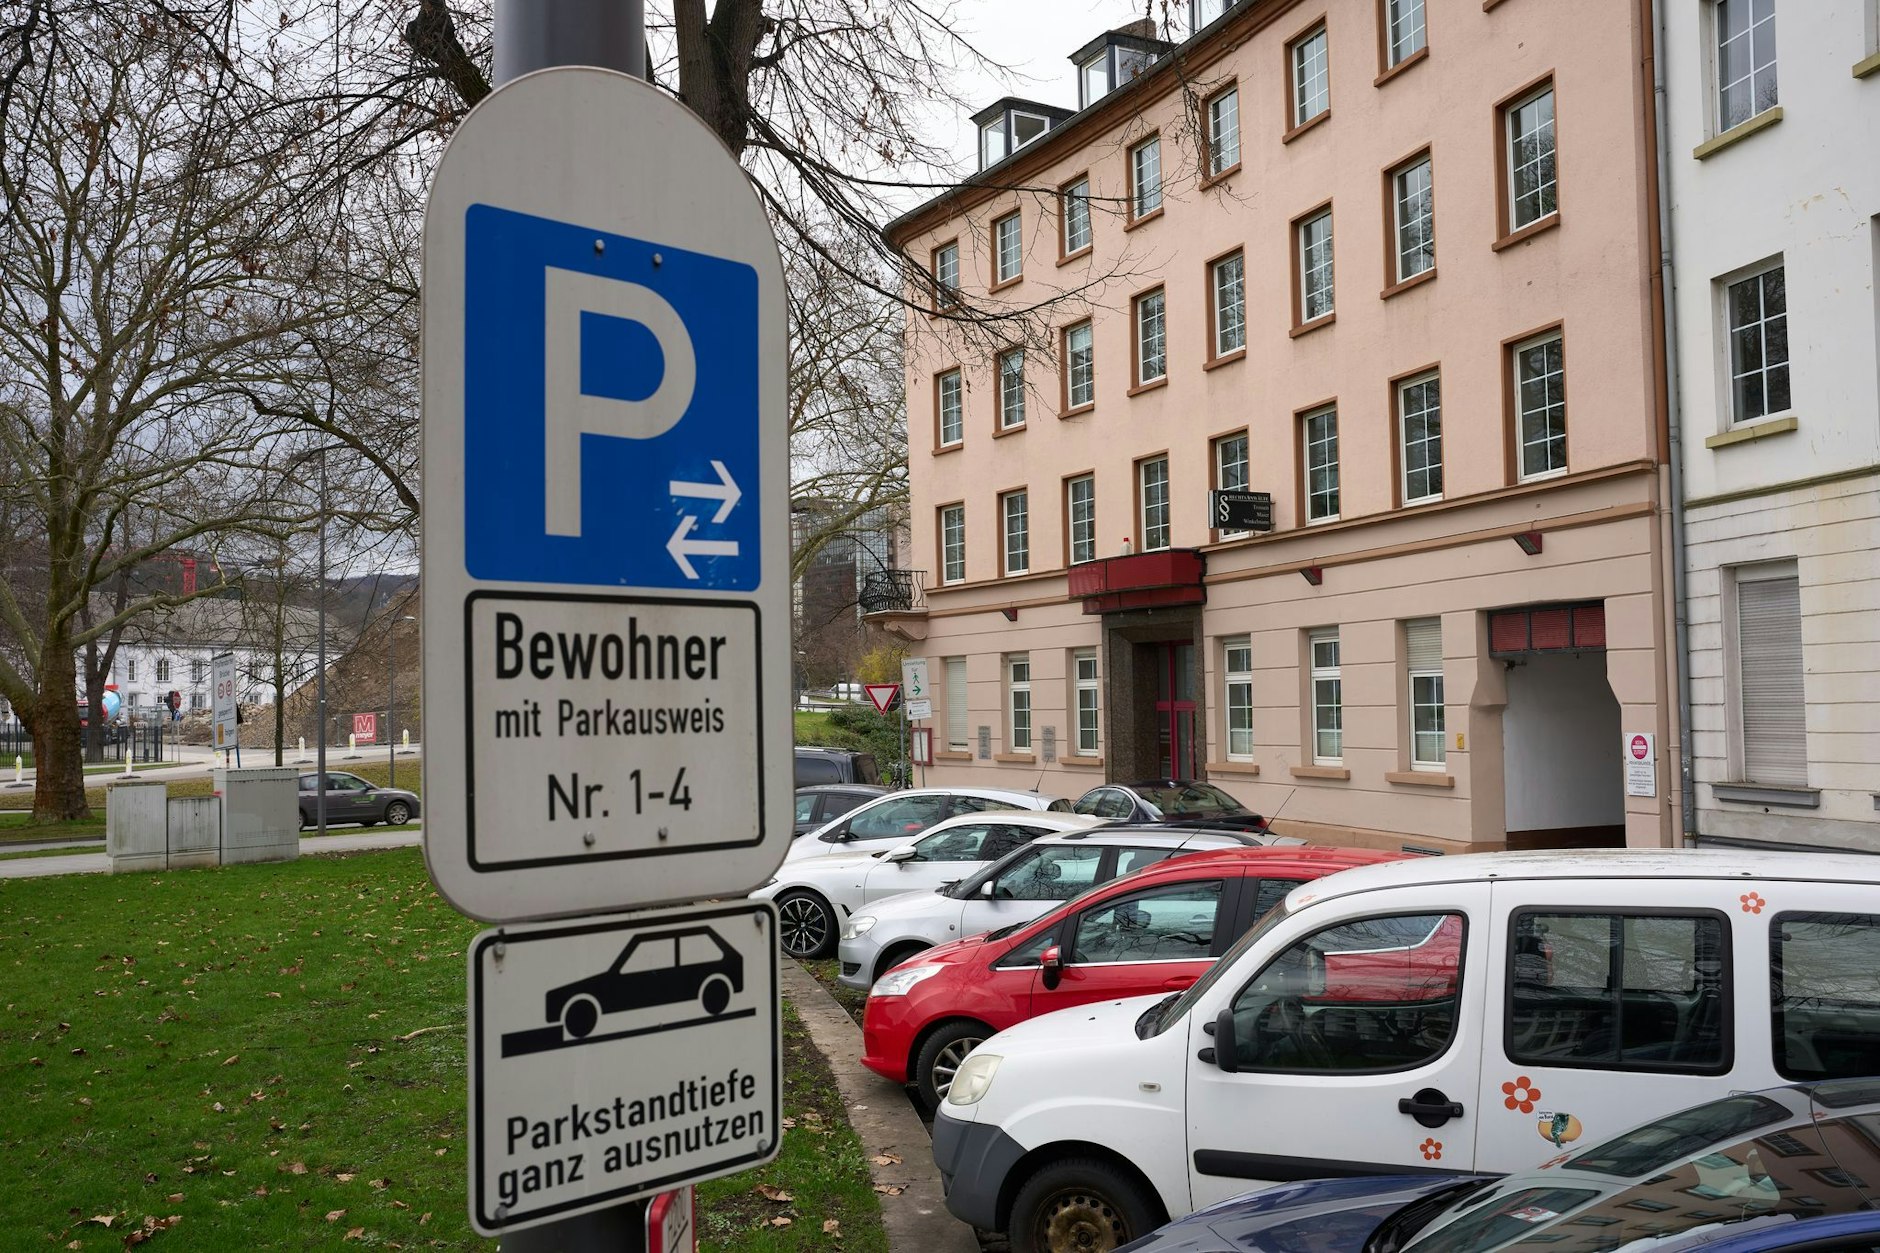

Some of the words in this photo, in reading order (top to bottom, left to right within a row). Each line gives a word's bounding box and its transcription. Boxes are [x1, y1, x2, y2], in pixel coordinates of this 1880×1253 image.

[545, 265, 697, 538] P
[496, 612, 727, 680] Bewohner
[496, 699, 541, 738] mit
[558, 698, 724, 737] Parkausweis
[548, 773, 609, 821] Nr.
[629, 767, 692, 814] 1-4
[507, 1068, 756, 1155] Parkstandtiefe
[499, 1154, 584, 1208] ganz
[604, 1110, 764, 1173] ausnutzen
